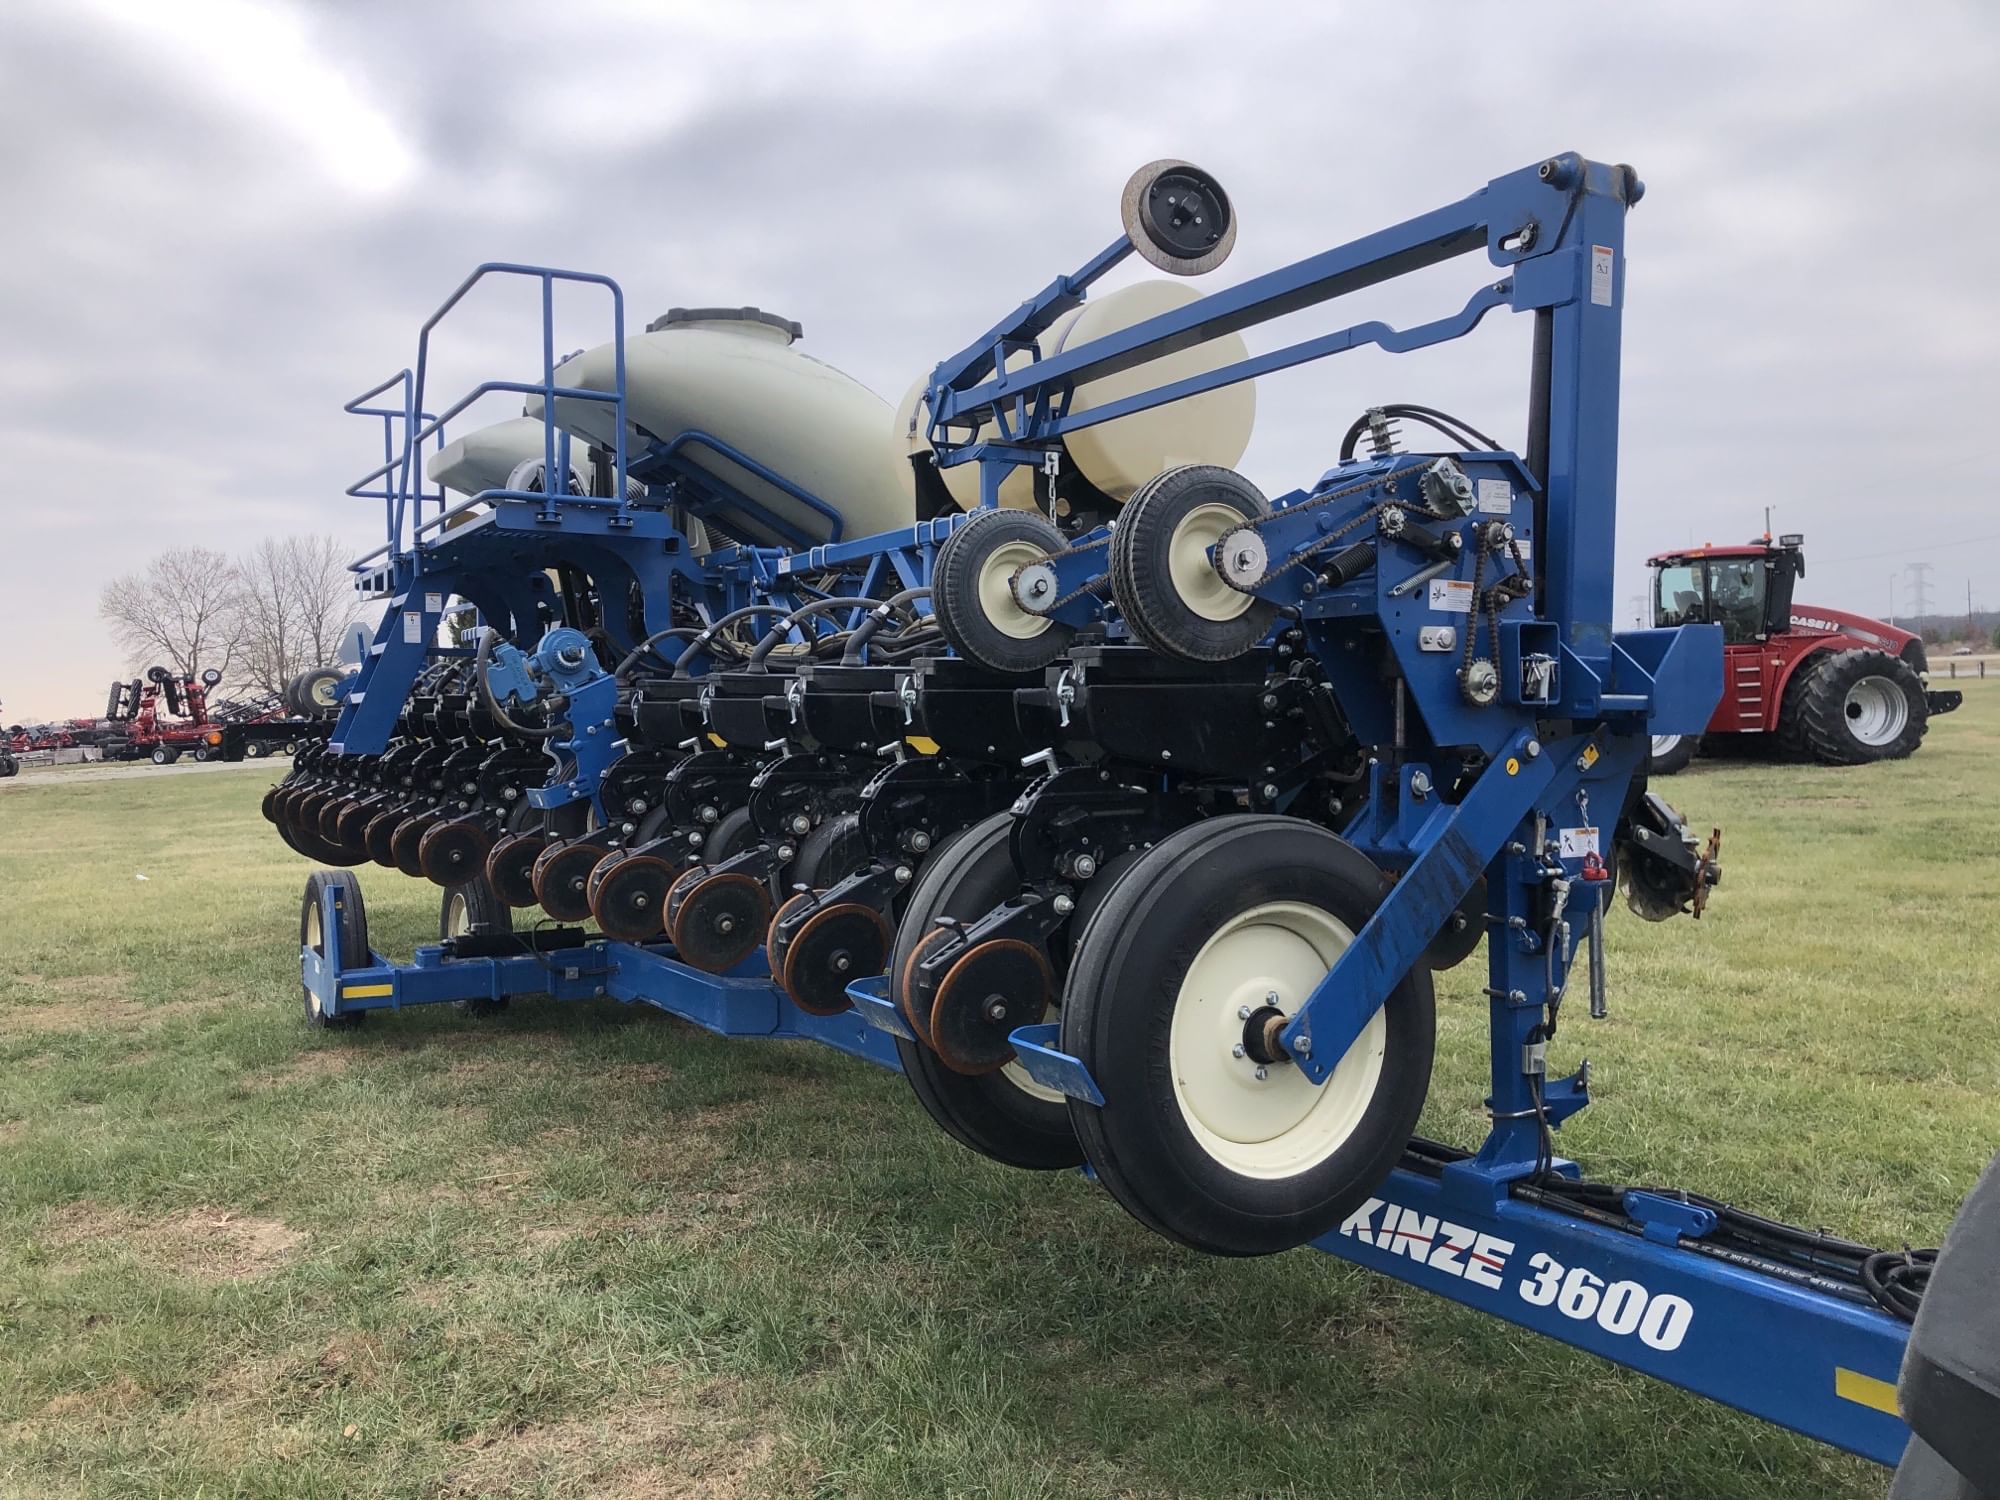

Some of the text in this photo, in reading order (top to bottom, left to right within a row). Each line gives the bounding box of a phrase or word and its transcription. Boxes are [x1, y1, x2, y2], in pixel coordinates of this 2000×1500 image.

[1789, 615, 1826, 630] CASE
[1339, 1197, 1516, 1291] KINZE
[1518, 1252, 1695, 1352] 3600
